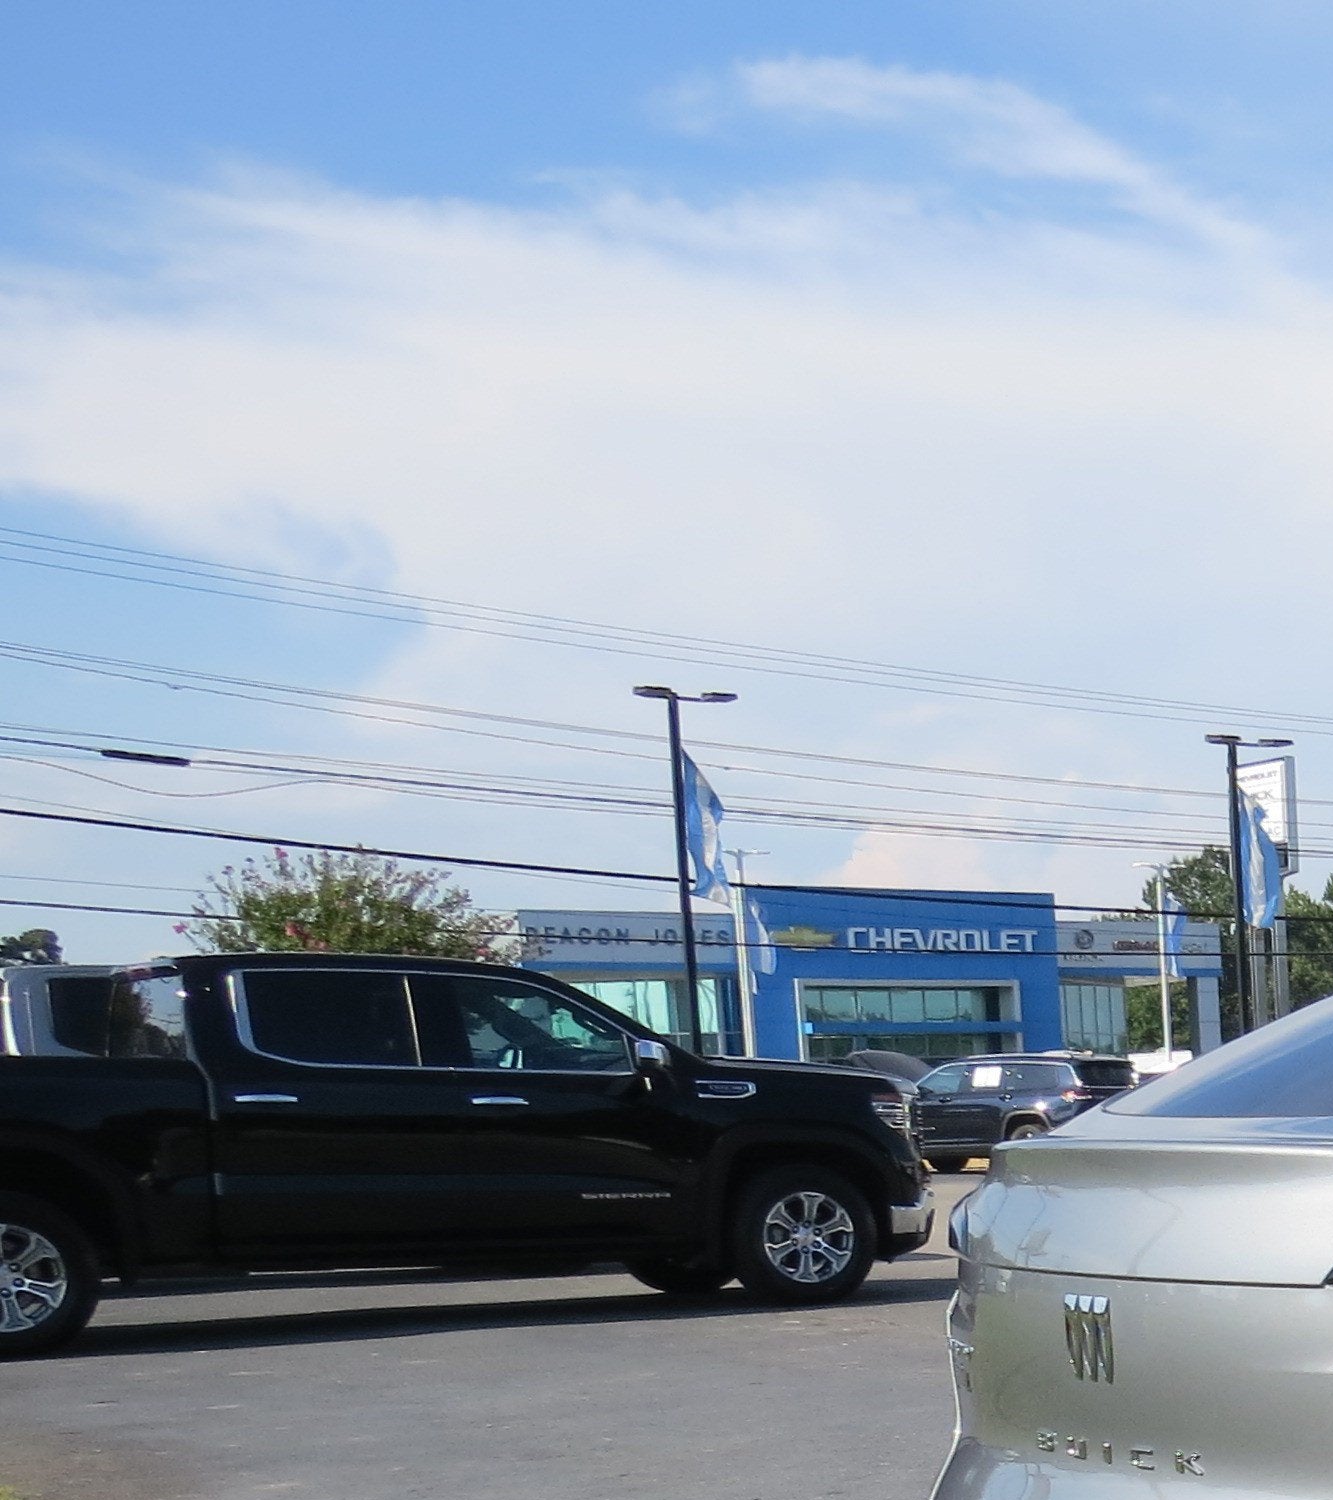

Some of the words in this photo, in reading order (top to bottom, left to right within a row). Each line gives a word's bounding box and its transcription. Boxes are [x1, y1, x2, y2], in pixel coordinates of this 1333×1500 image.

[650, 928, 730, 947] JOES
[847, 927, 1038, 953] CHEVROLET
[1037, 1430, 1205, 1476] BUICK
